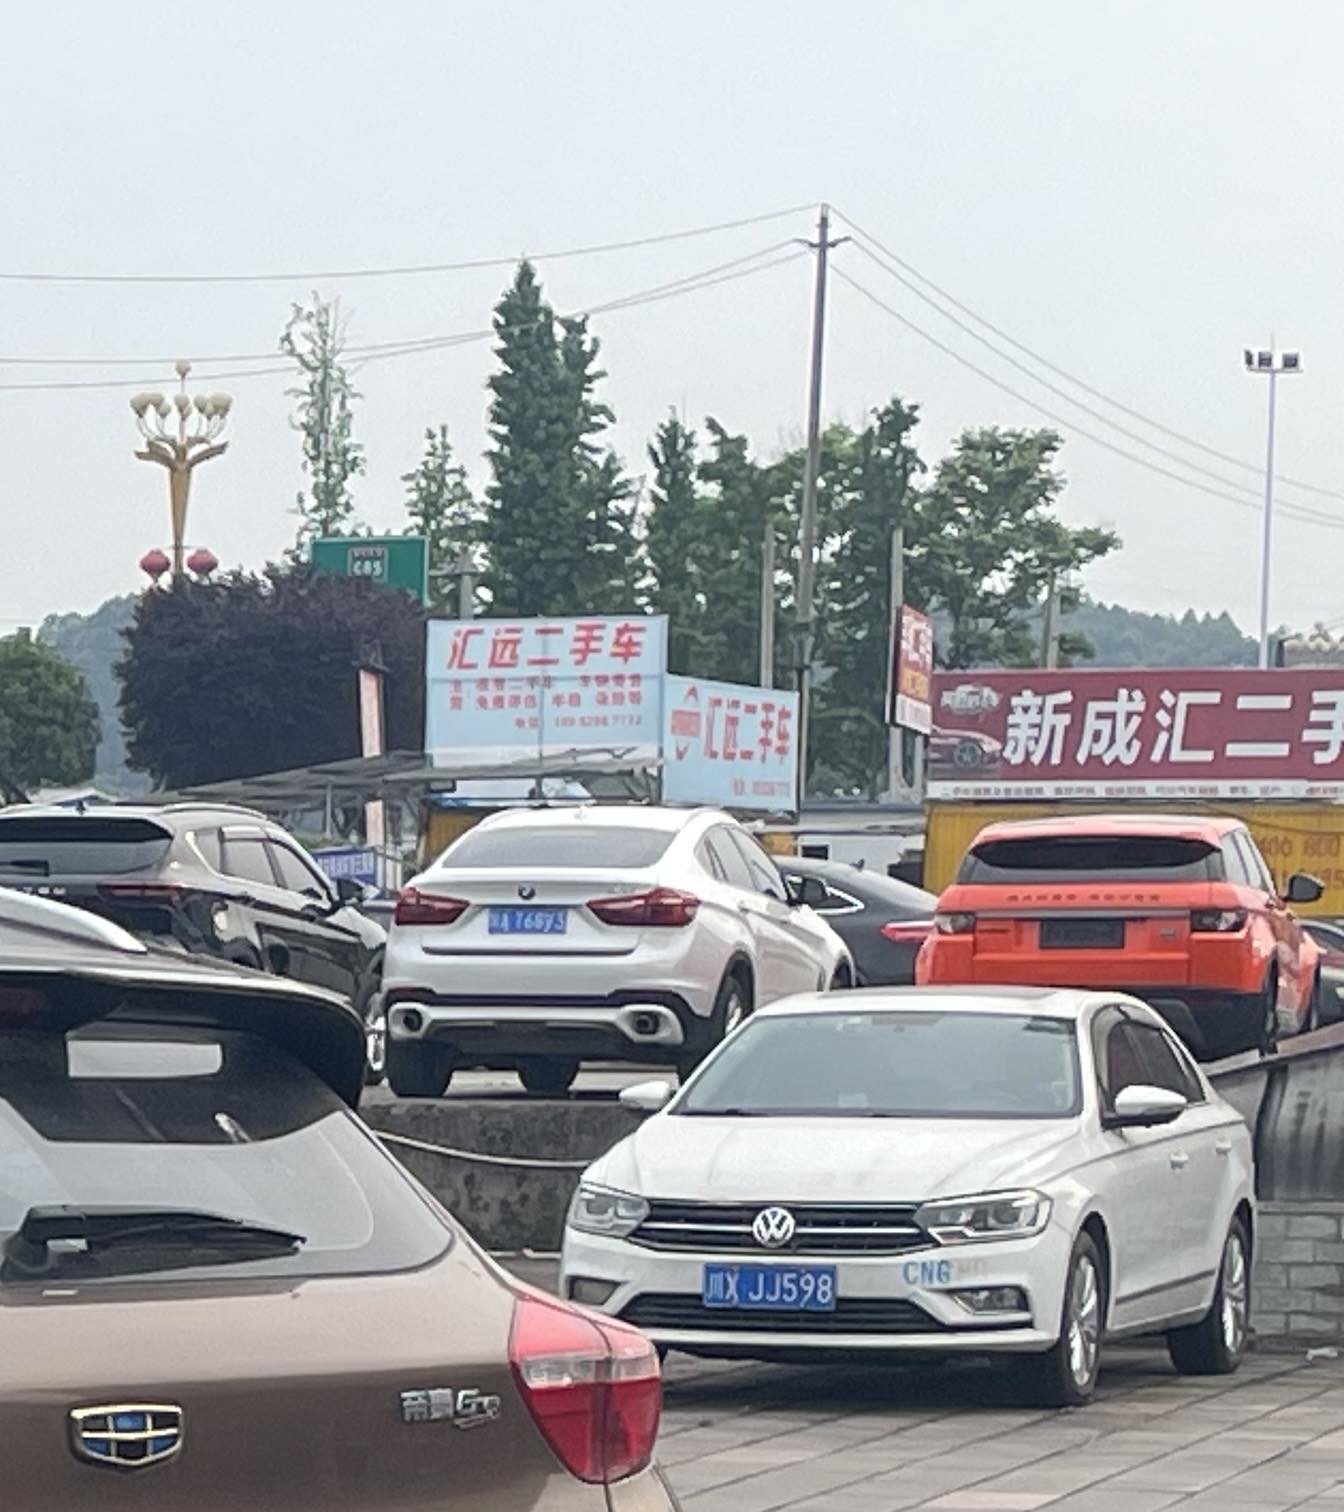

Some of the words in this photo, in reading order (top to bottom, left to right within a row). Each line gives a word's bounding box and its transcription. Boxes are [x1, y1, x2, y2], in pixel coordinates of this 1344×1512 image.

[446, 622, 648, 671] 汇远二手车
[747, 1272, 833, 1308] JJ598
[902, 1259, 953, 1286] CNG
